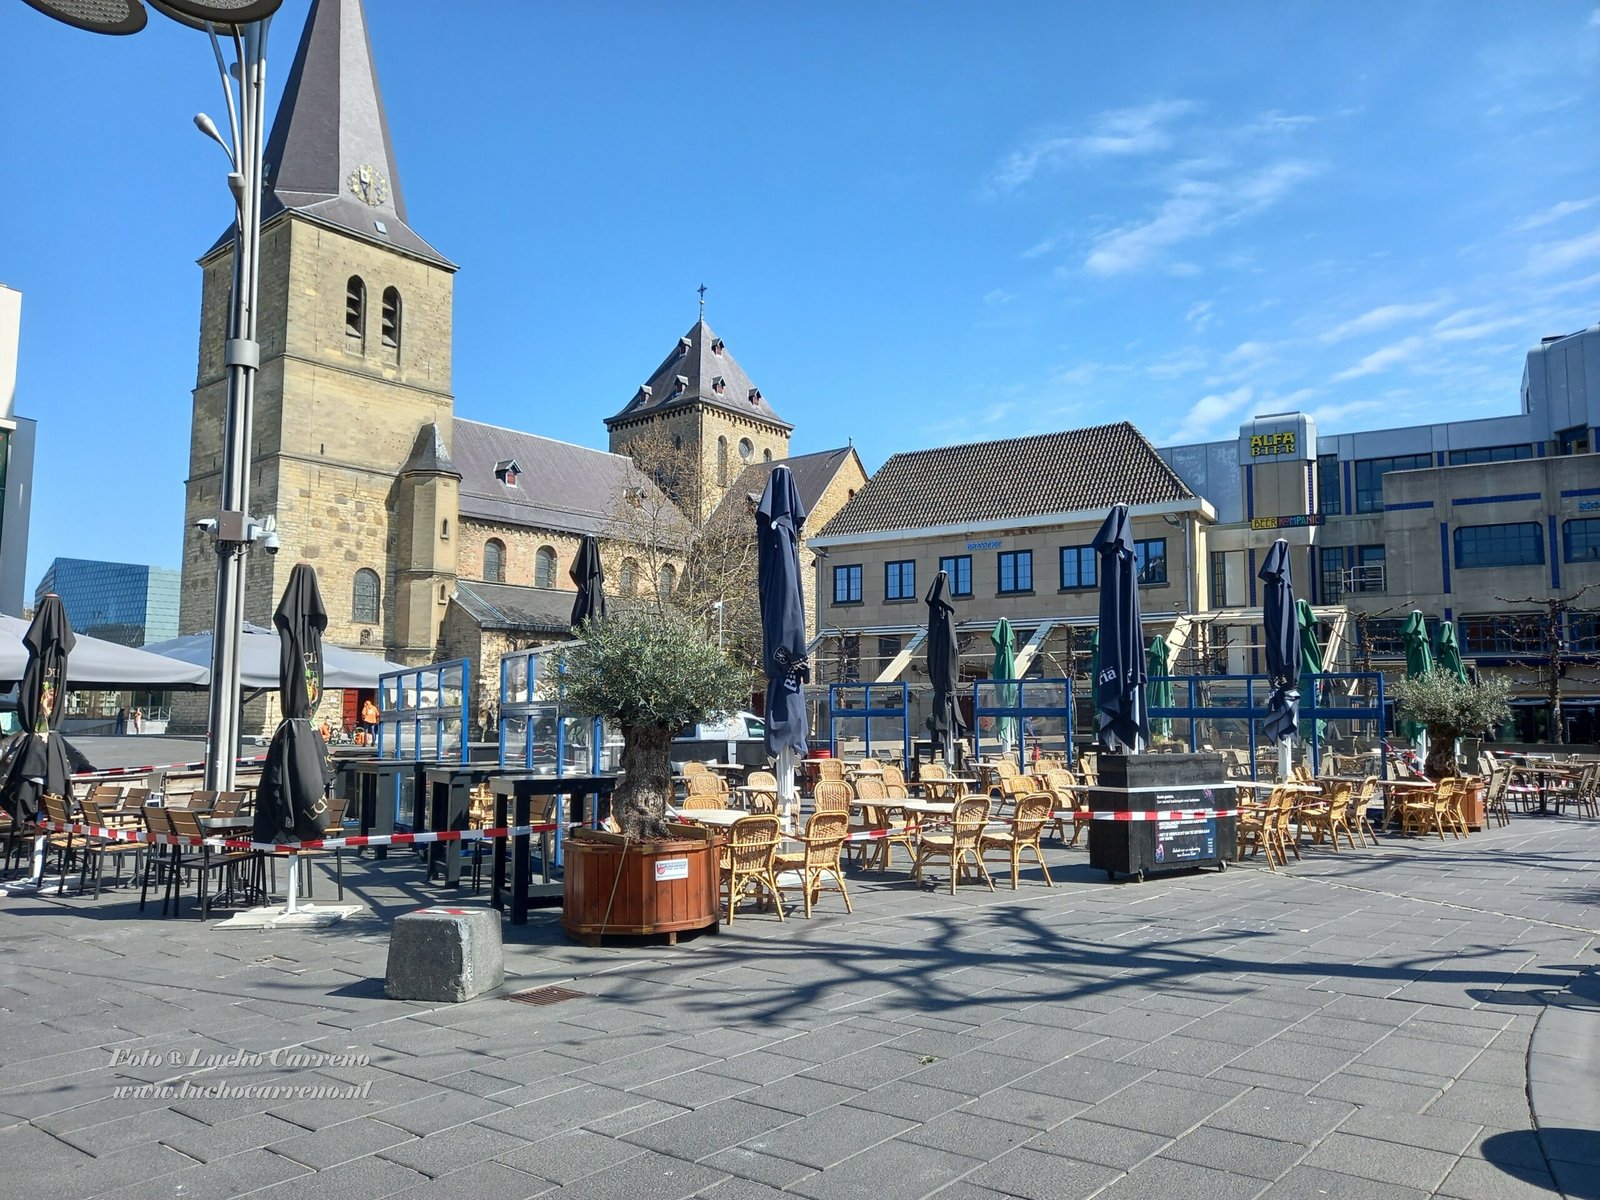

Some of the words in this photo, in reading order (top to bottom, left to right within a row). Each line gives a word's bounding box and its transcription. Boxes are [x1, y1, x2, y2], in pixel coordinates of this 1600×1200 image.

[1250, 432, 1295, 447] ALFA
[1251, 444, 1295, 456] BIER
[1254, 518, 1277, 528] BEER
